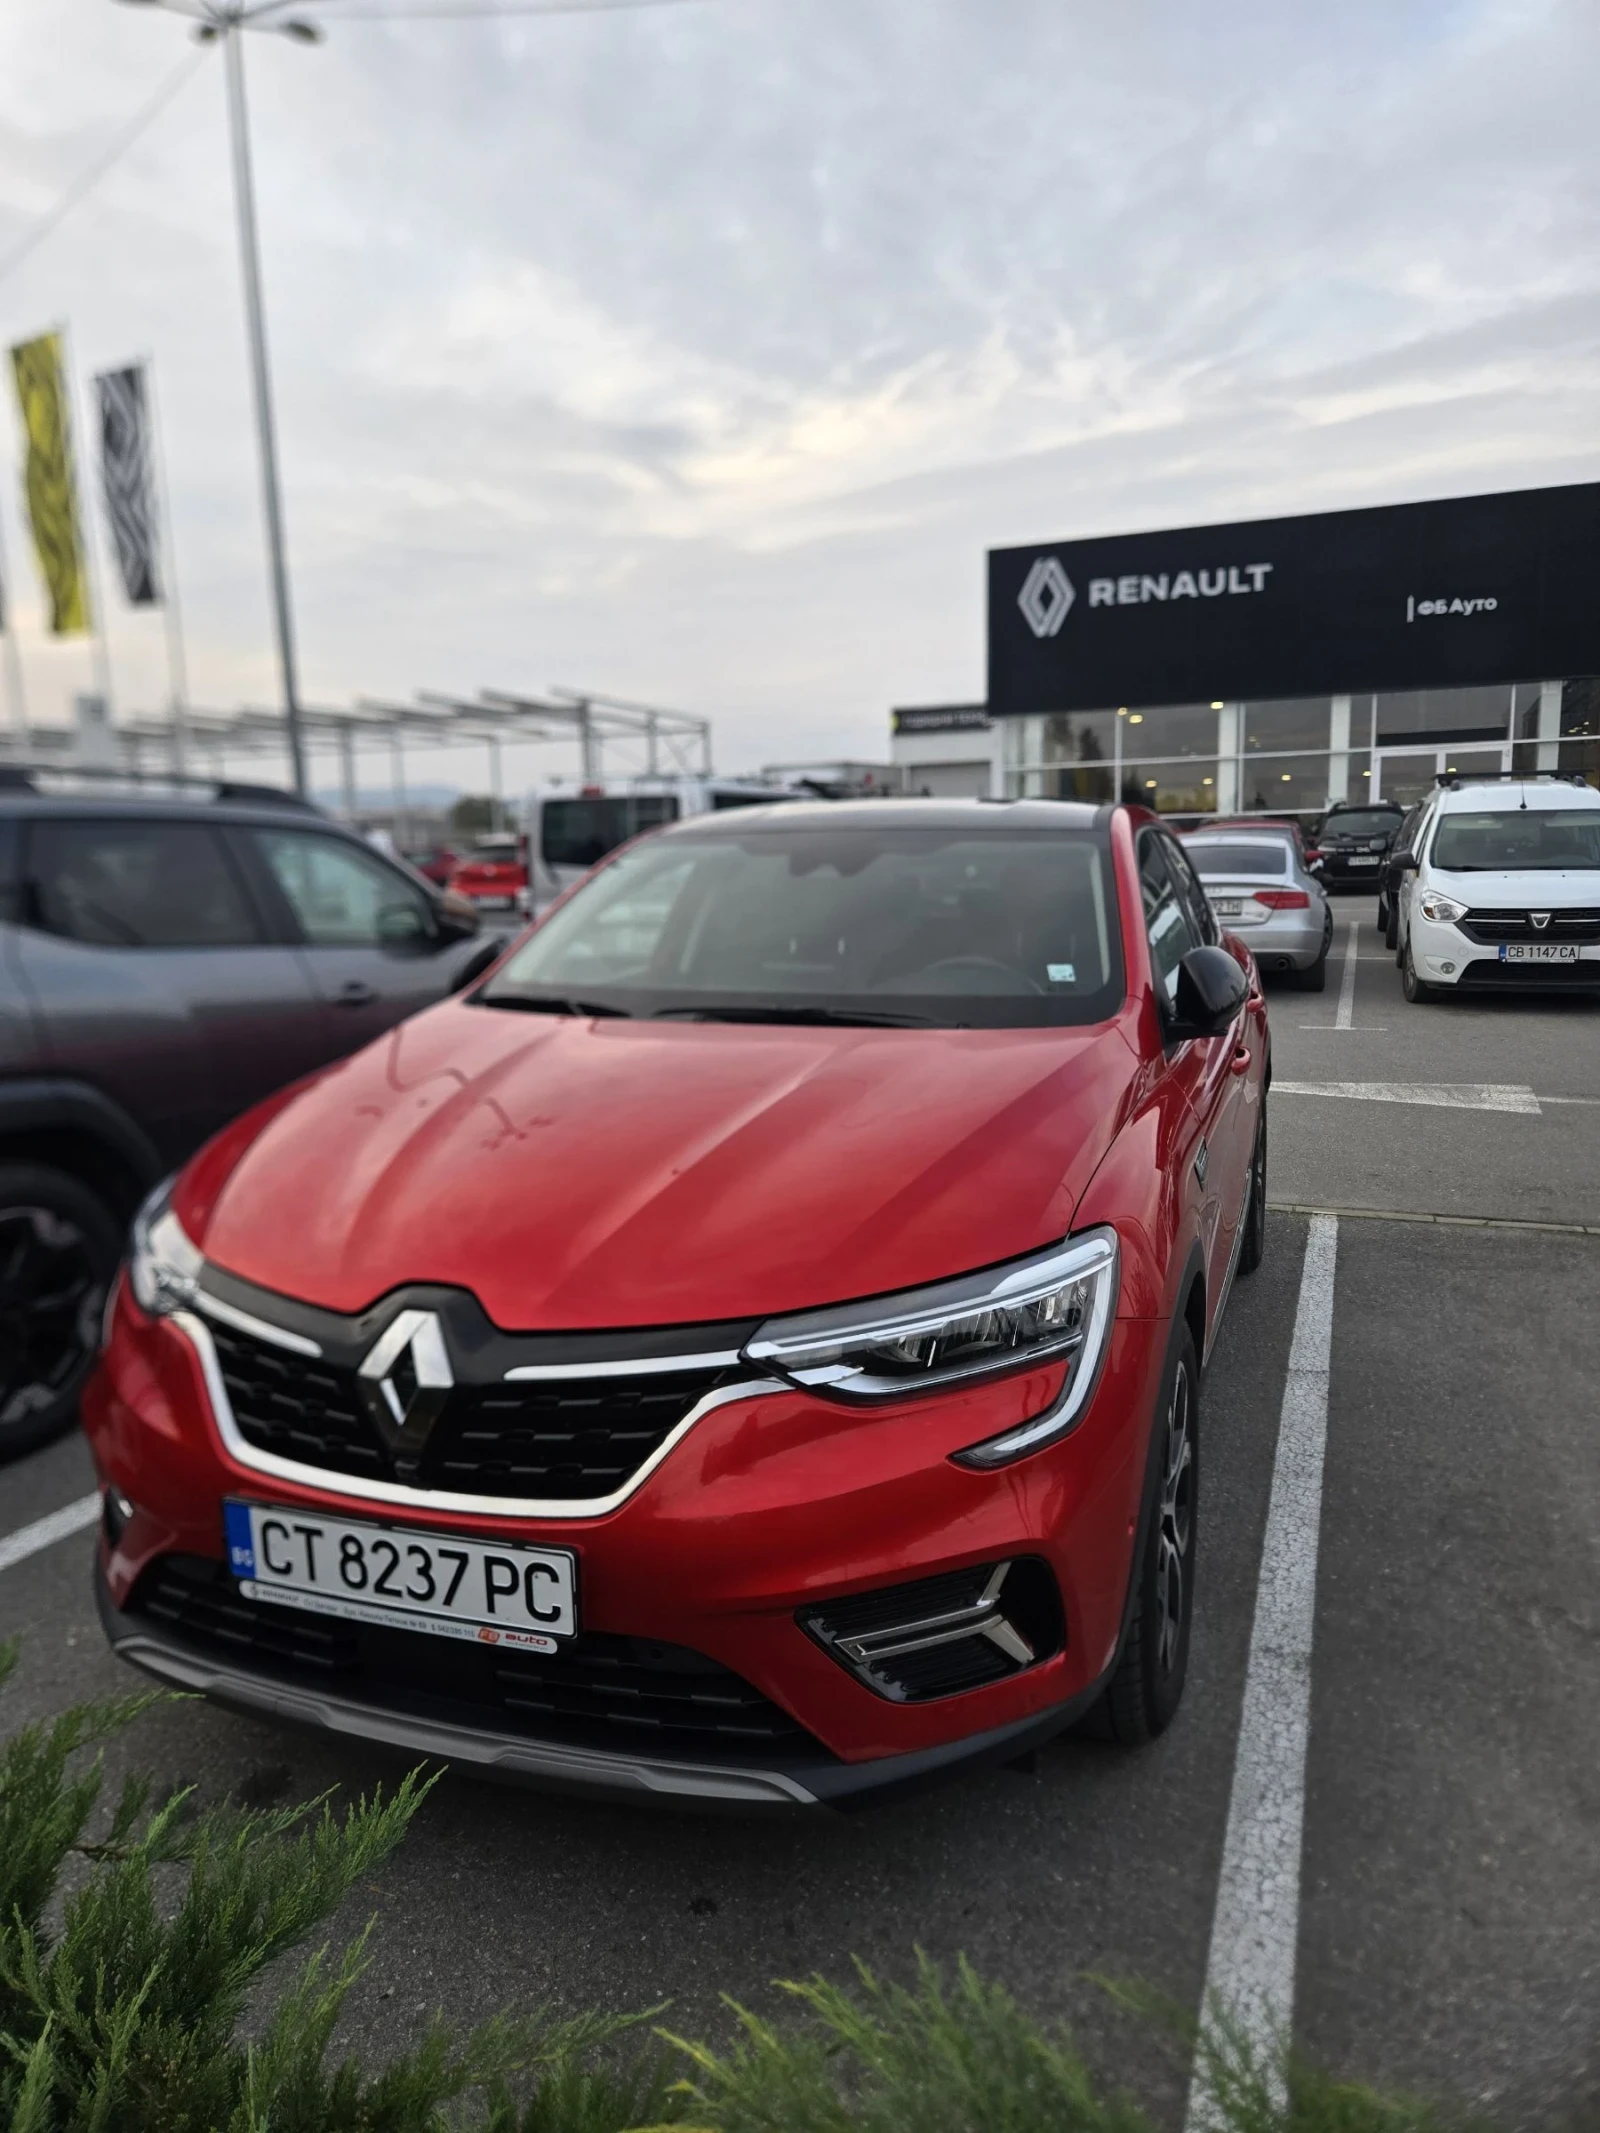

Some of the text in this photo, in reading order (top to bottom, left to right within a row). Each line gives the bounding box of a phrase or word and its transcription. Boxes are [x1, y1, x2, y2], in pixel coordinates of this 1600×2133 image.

[1088, 562, 1274, 608] RENAULT
[1508, 946, 1576, 958] CB 1147 CA
[261, 1520, 563, 1623] CT 8237 PC
[505, 1633, 548, 1646] auto
